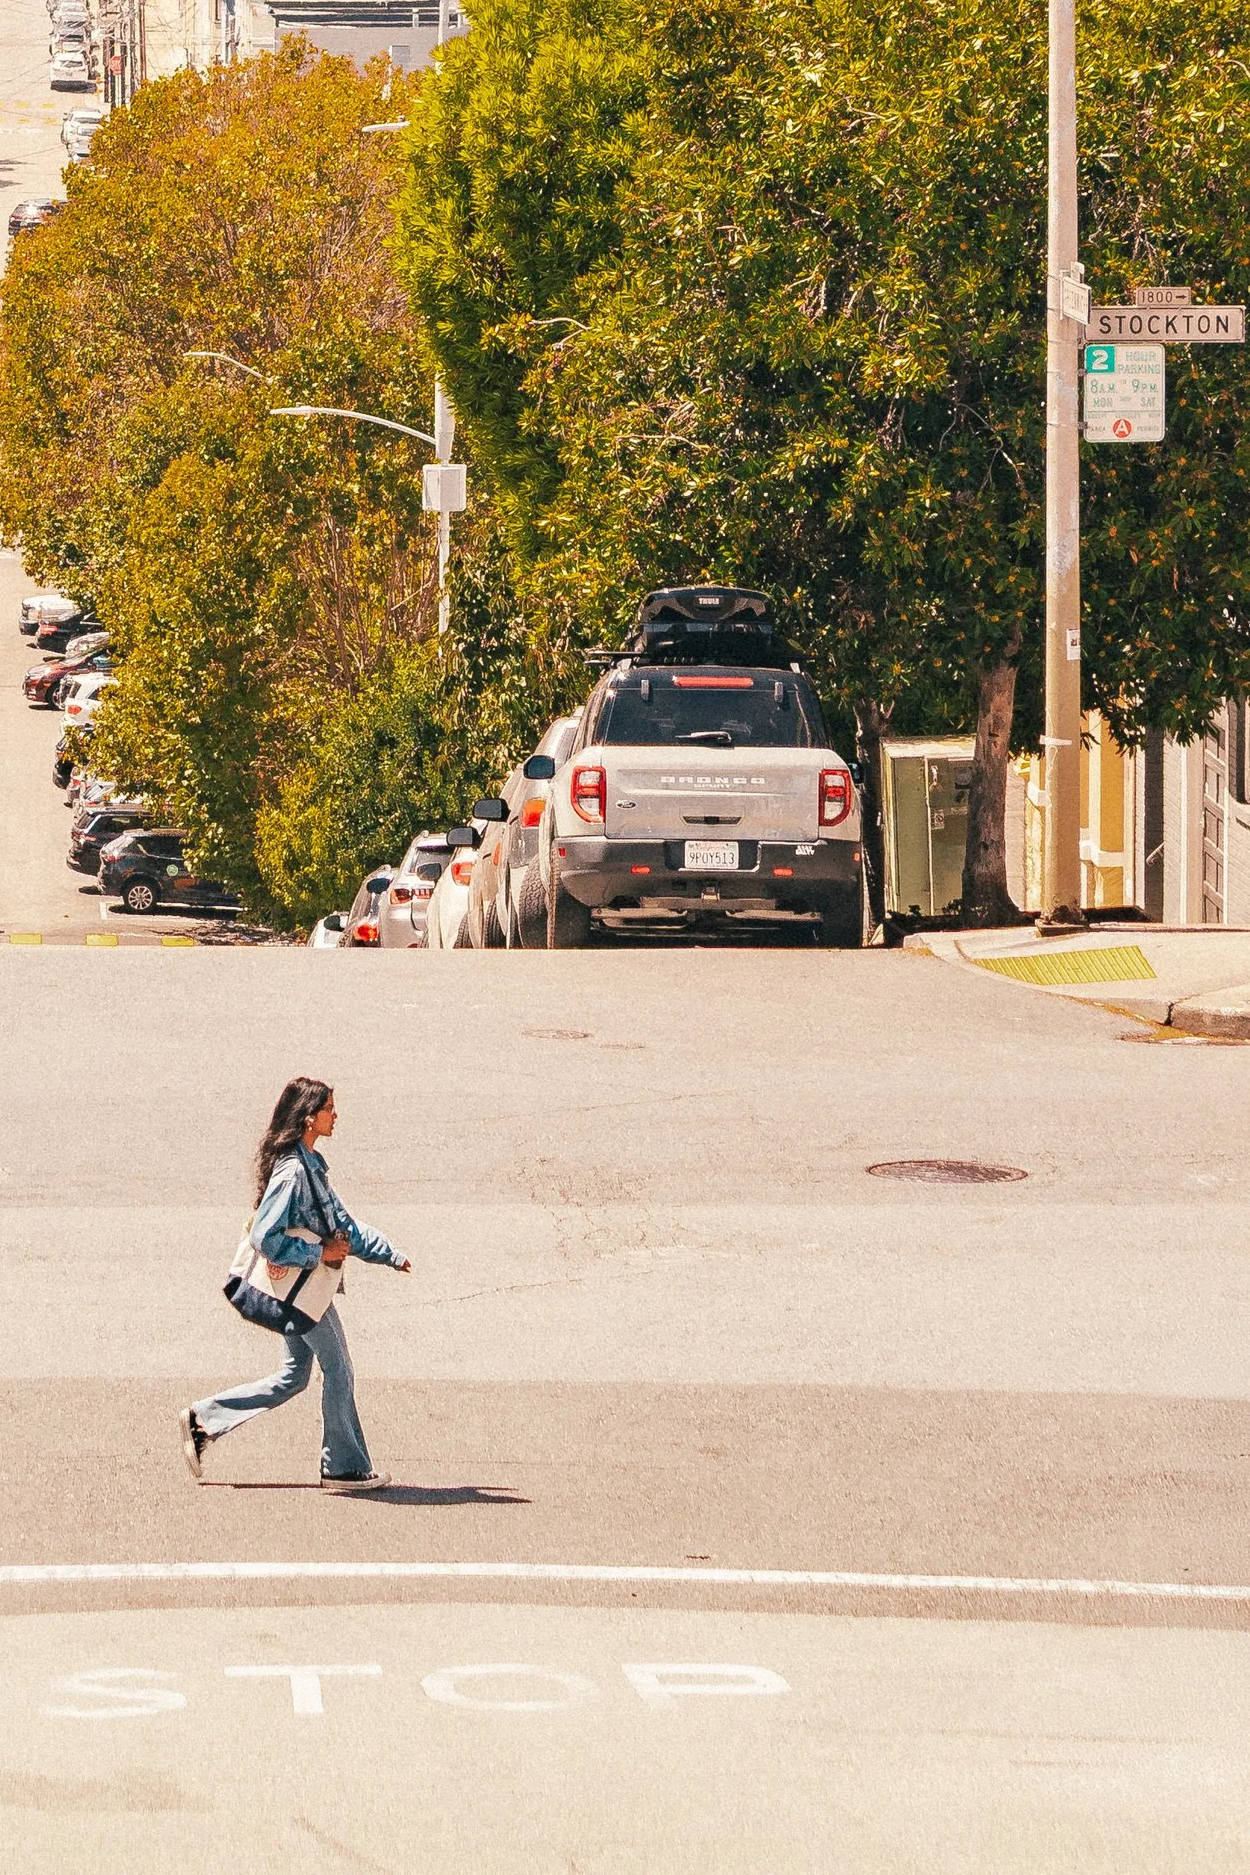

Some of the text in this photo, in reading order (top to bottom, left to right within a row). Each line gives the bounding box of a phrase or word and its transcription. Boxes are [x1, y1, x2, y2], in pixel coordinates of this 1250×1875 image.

[1141, 291, 1173, 303] 1800
[1099, 315, 1229, 334] STOCKTON
[1092, 350, 1109, 370] 2
[1125, 351, 1157, 362] HOUR
[1117, 364, 1161, 374] PARKING
[1093, 397, 1113, 407] MON
[1140, 397, 1156, 407] SAT
[1114, 419, 1129, 435] A
[660, 776, 766, 785] BRONCO
[39, 1662, 792, 1719] STOP
